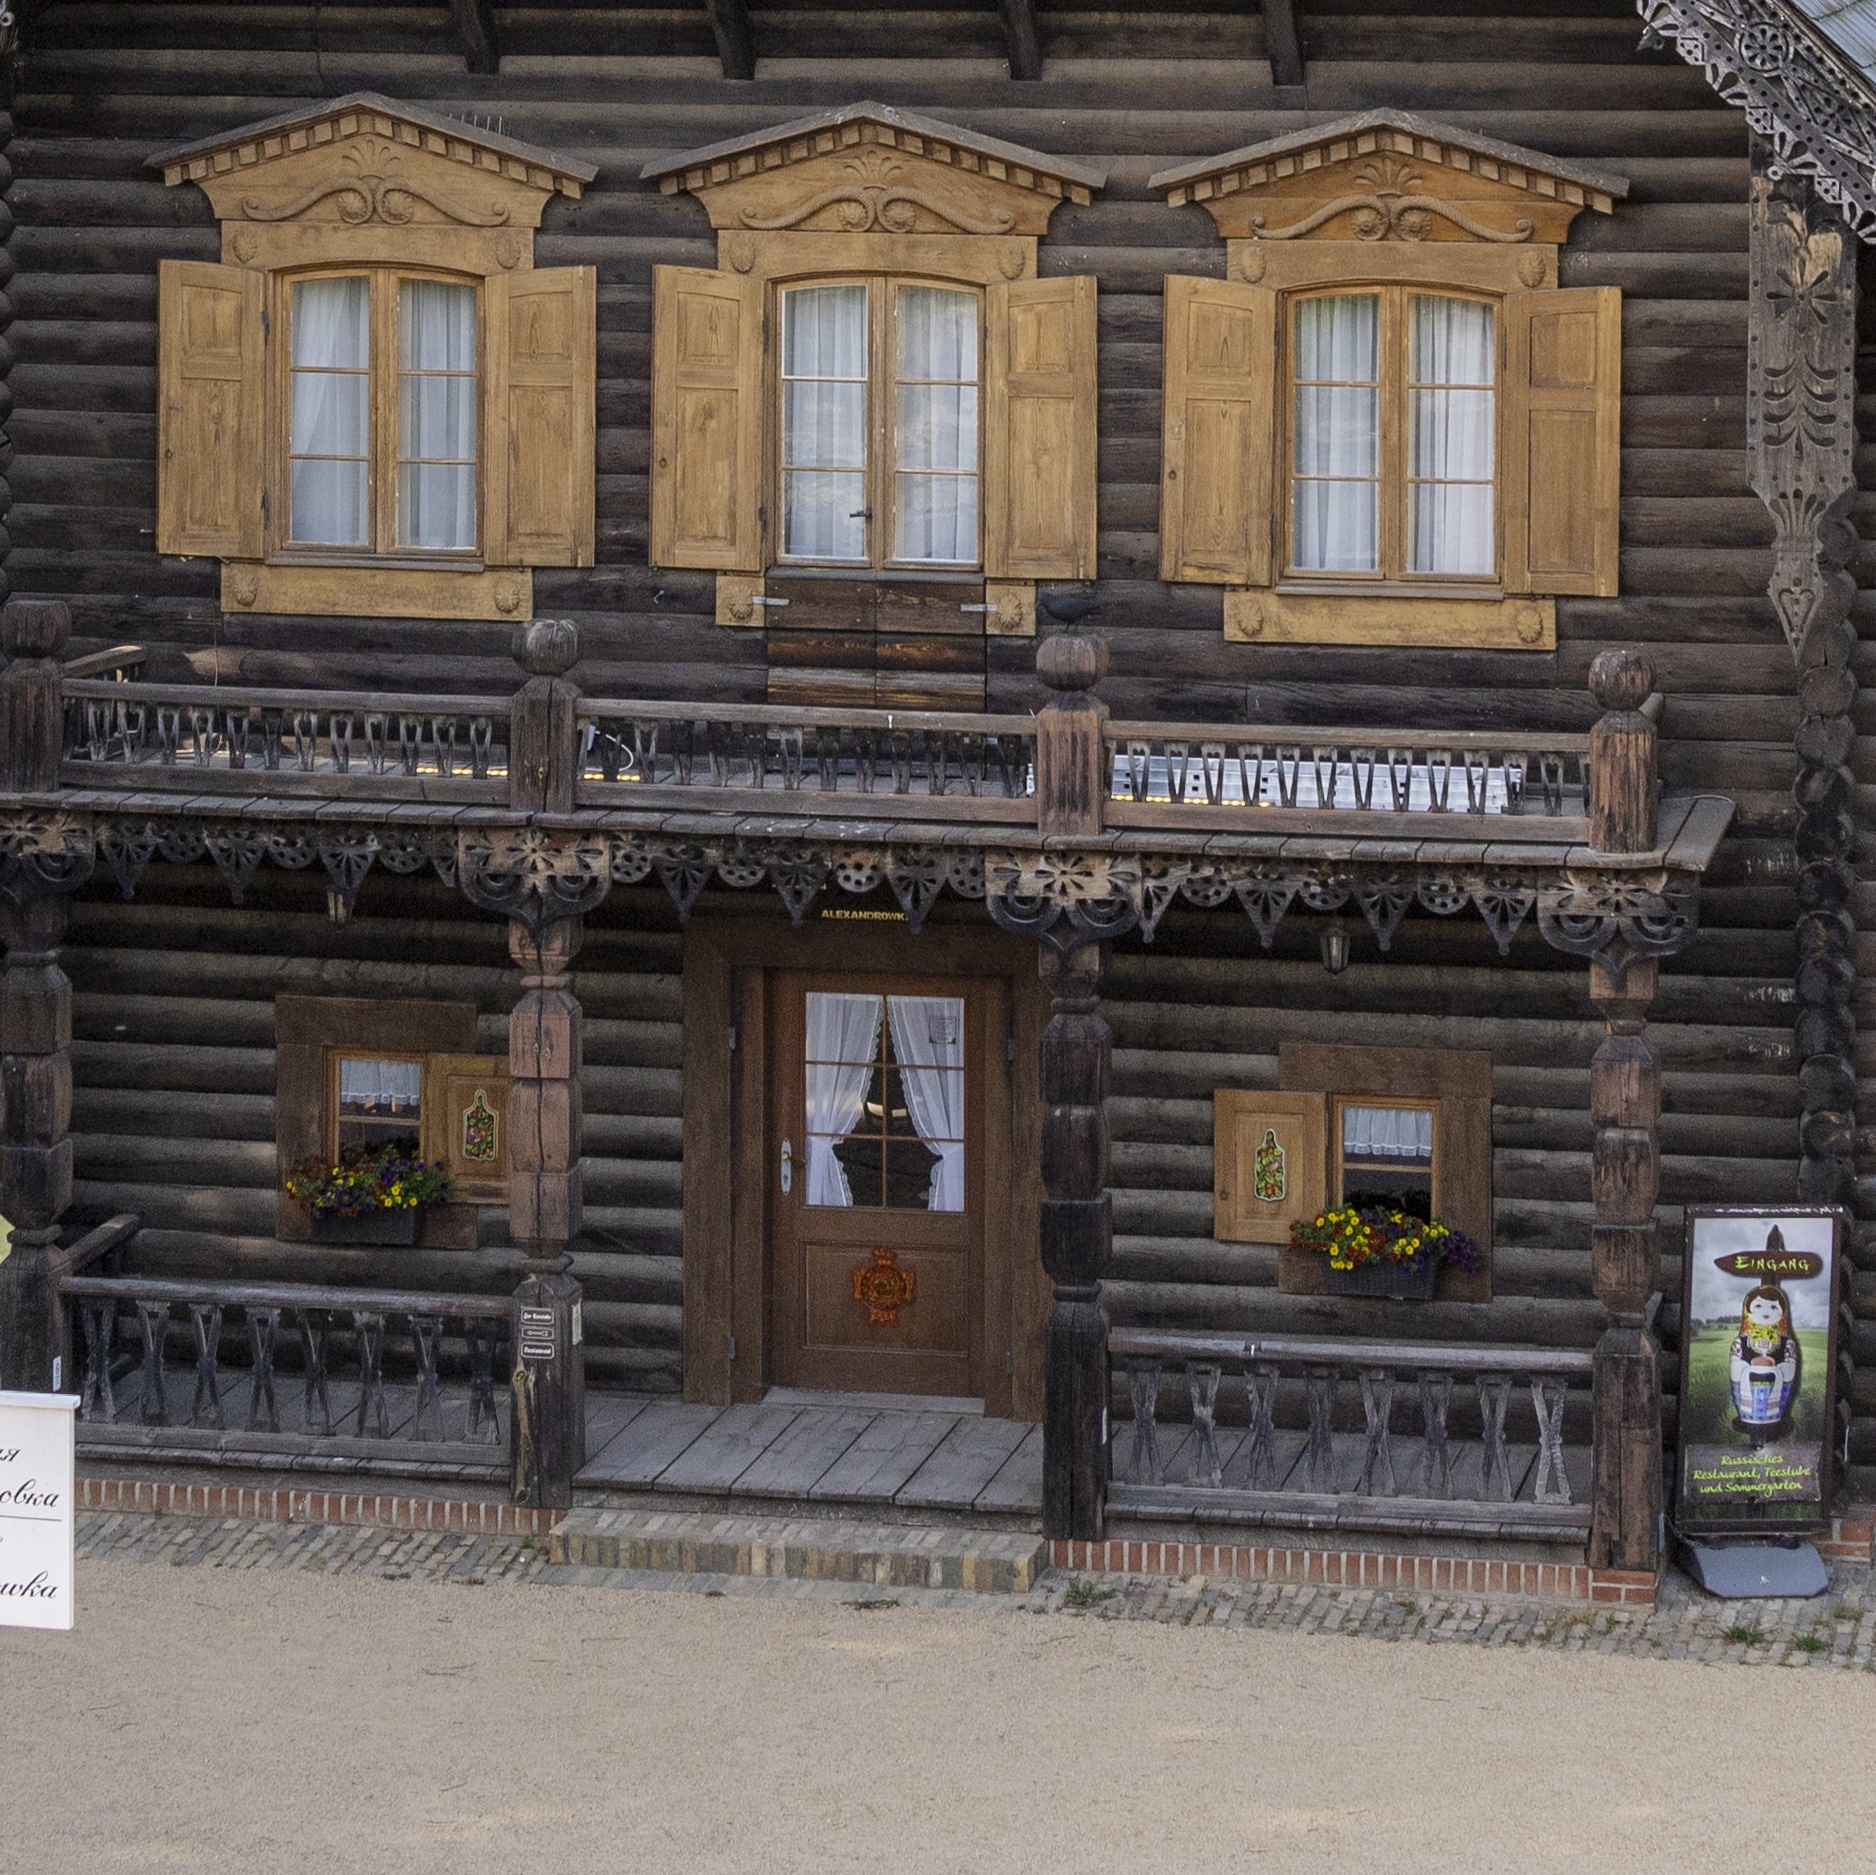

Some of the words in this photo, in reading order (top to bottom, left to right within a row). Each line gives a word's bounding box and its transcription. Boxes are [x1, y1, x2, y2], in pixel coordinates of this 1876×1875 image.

[821, 909, 909, 922] ALEXANDROWK
[1734, 1255, 1810, 1272] EINGANG
[1720, 1454, 1784, 1465] Russisches
[1693, 1467, 1761, 1480] Restaurant,
[1765, 1465, 1812, 1478] Teestube
[1700, 1483, 1723, 1494] und
[1725, 1479, 1803, 1499] Sommergarten
